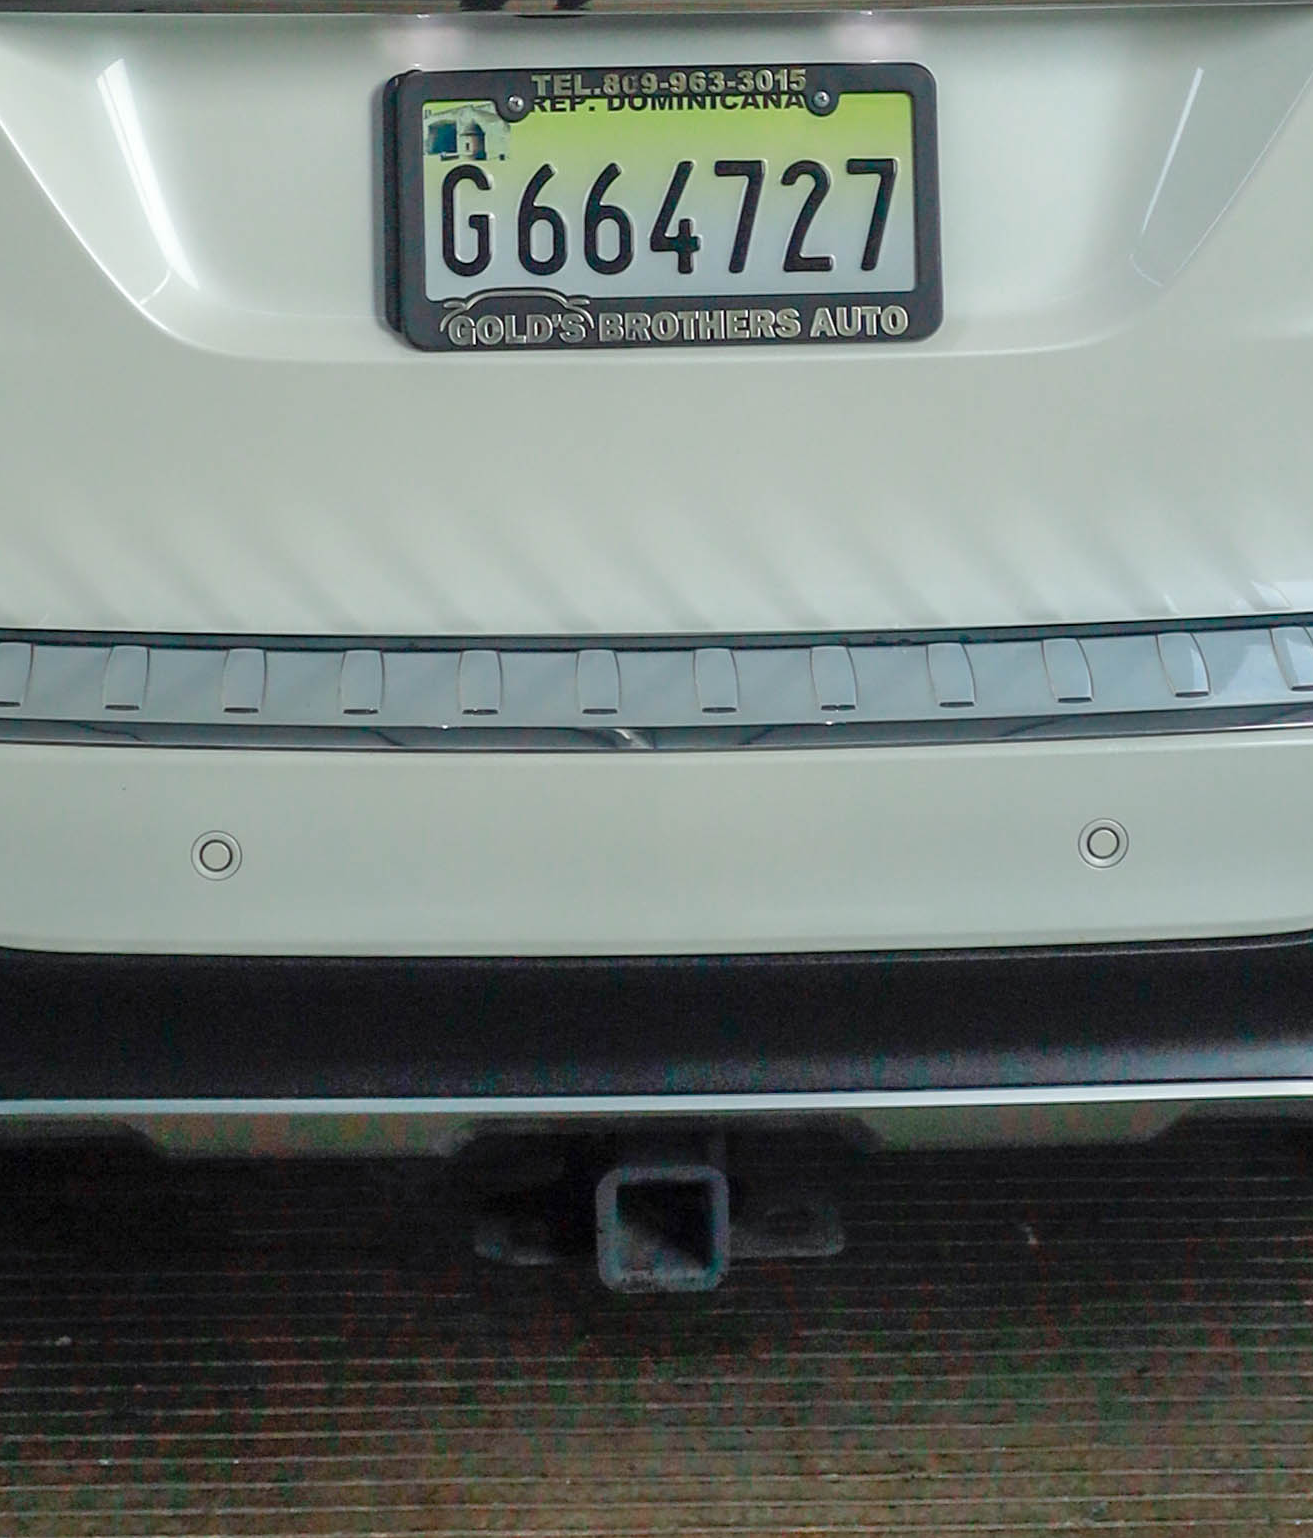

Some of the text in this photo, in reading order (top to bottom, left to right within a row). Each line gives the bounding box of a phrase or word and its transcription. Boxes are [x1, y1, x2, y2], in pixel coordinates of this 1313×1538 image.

[441, 157, 899, 278] G664727
[447, 304, 910, 346] GOLD'S BROTHERS AUTO
